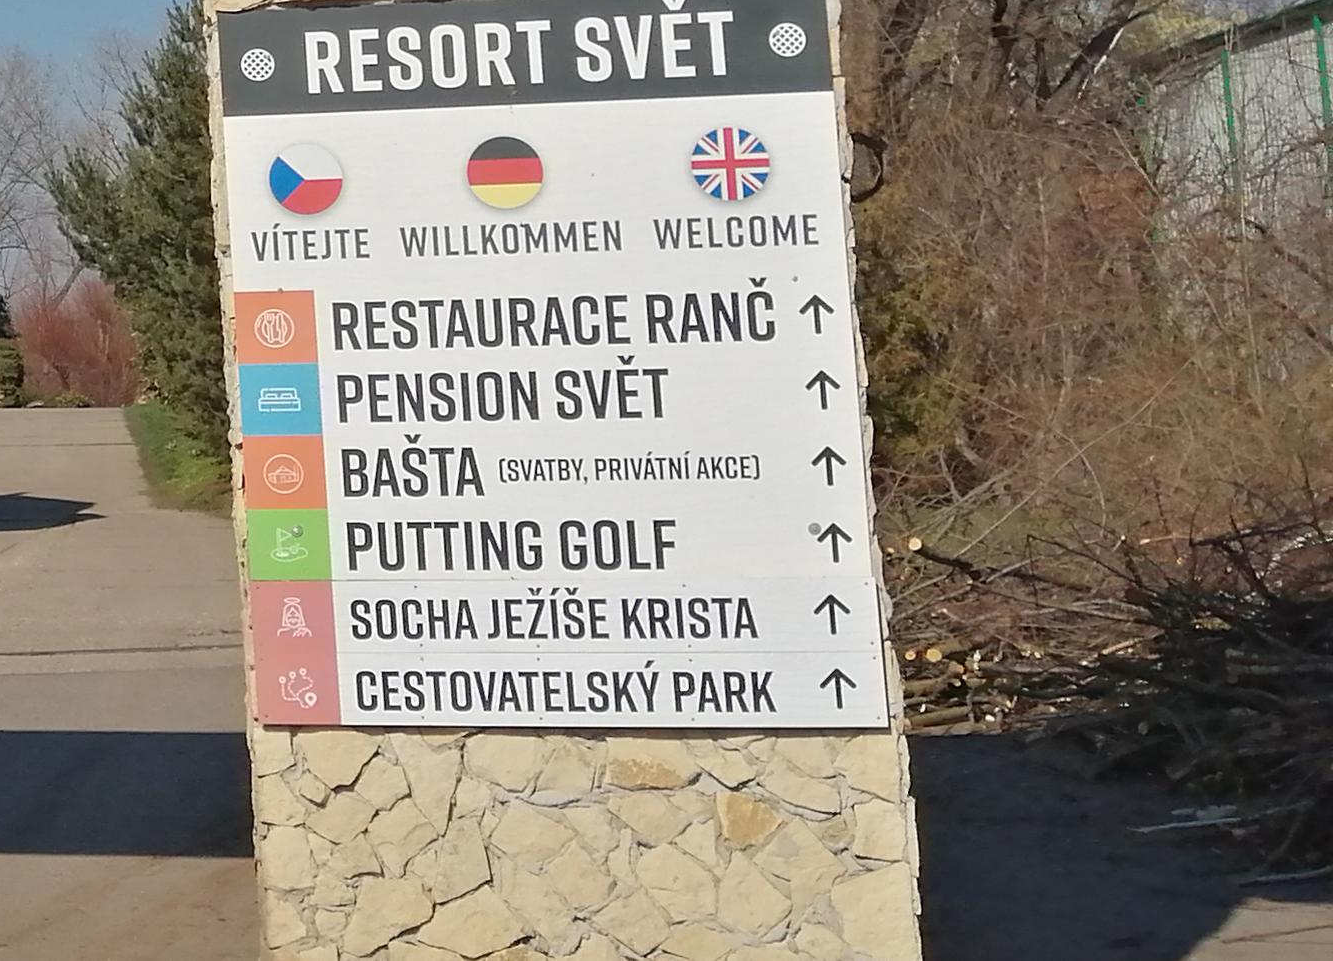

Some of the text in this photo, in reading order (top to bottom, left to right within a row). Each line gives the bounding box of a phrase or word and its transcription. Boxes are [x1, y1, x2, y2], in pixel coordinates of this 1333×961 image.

[305, 20, 550, 93] RESORT
[251, 223, 370, 261] VÍTEJTE
[400, 220, 622, 257] WILLKOMMEN
[653, 214, 819, 250] WELCOME
[332, 278, 775, 350] RESTAURACE RANČ
[337, 356, 668, 423] PENSION SVĚT
[341, 434, 760, 497] BAŠTA (SVATBY, PRIVÁTNÍ AKCE)
[347, 520, 675, 571] PUTTING GOLF
[351, 588, 758, 639] SOCHA JEŽÍŠE KRISTA
[356, 660, 776, 712] CESTOVATELSKÝ PARK
